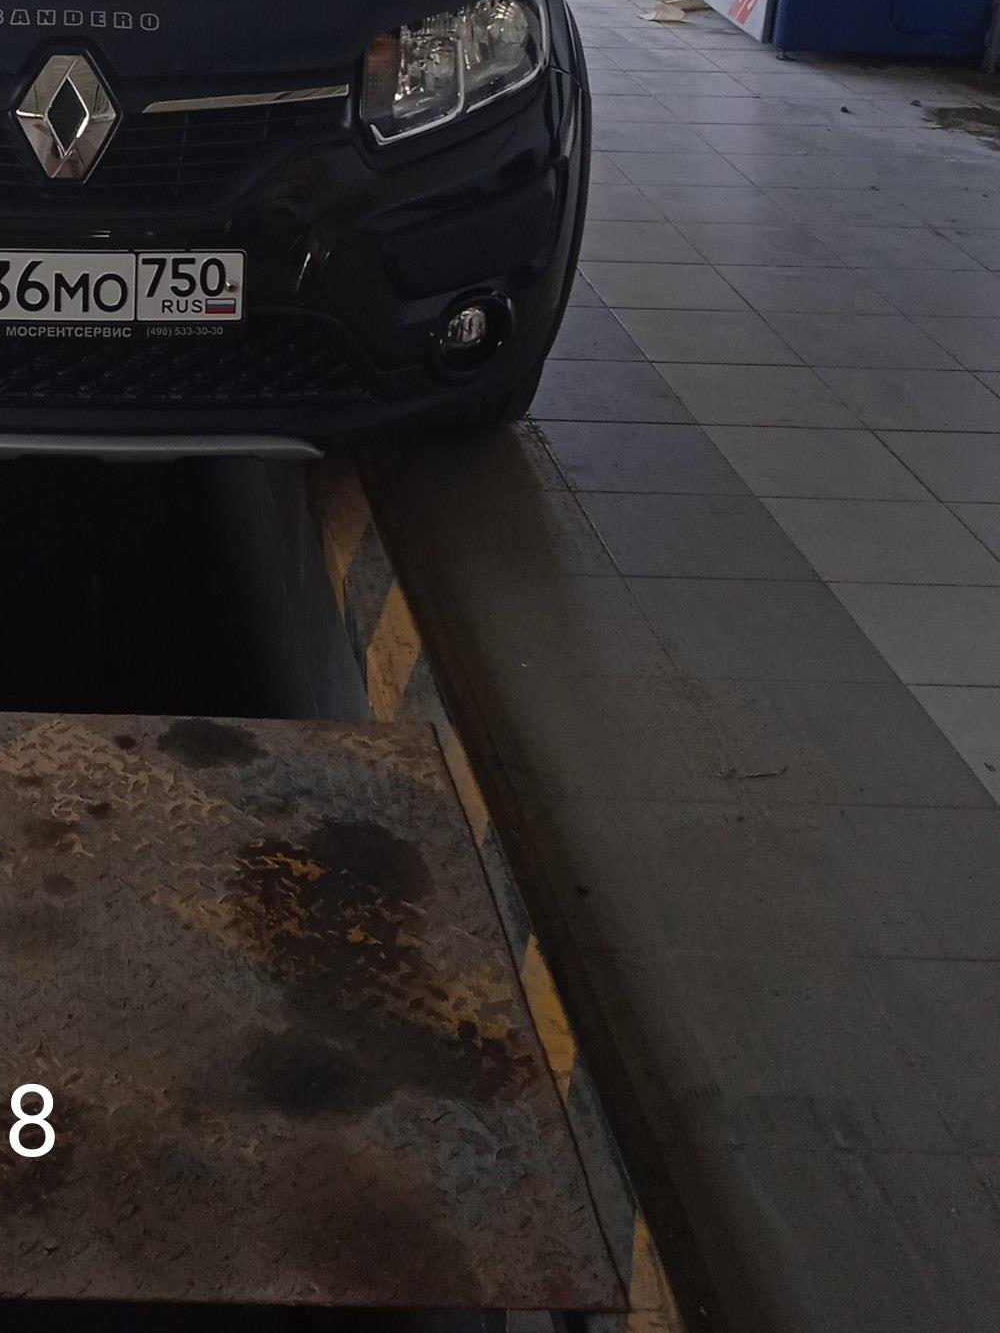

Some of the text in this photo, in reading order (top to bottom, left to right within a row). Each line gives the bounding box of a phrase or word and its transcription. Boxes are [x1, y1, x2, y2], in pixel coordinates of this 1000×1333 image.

[141, 257, 226, 299] 750
[161, 298, 203, 315] RUS
[5, 325, 133, 338] МОСРЕНТСЕРВИС
[146, 326, 173, 338] (498)
